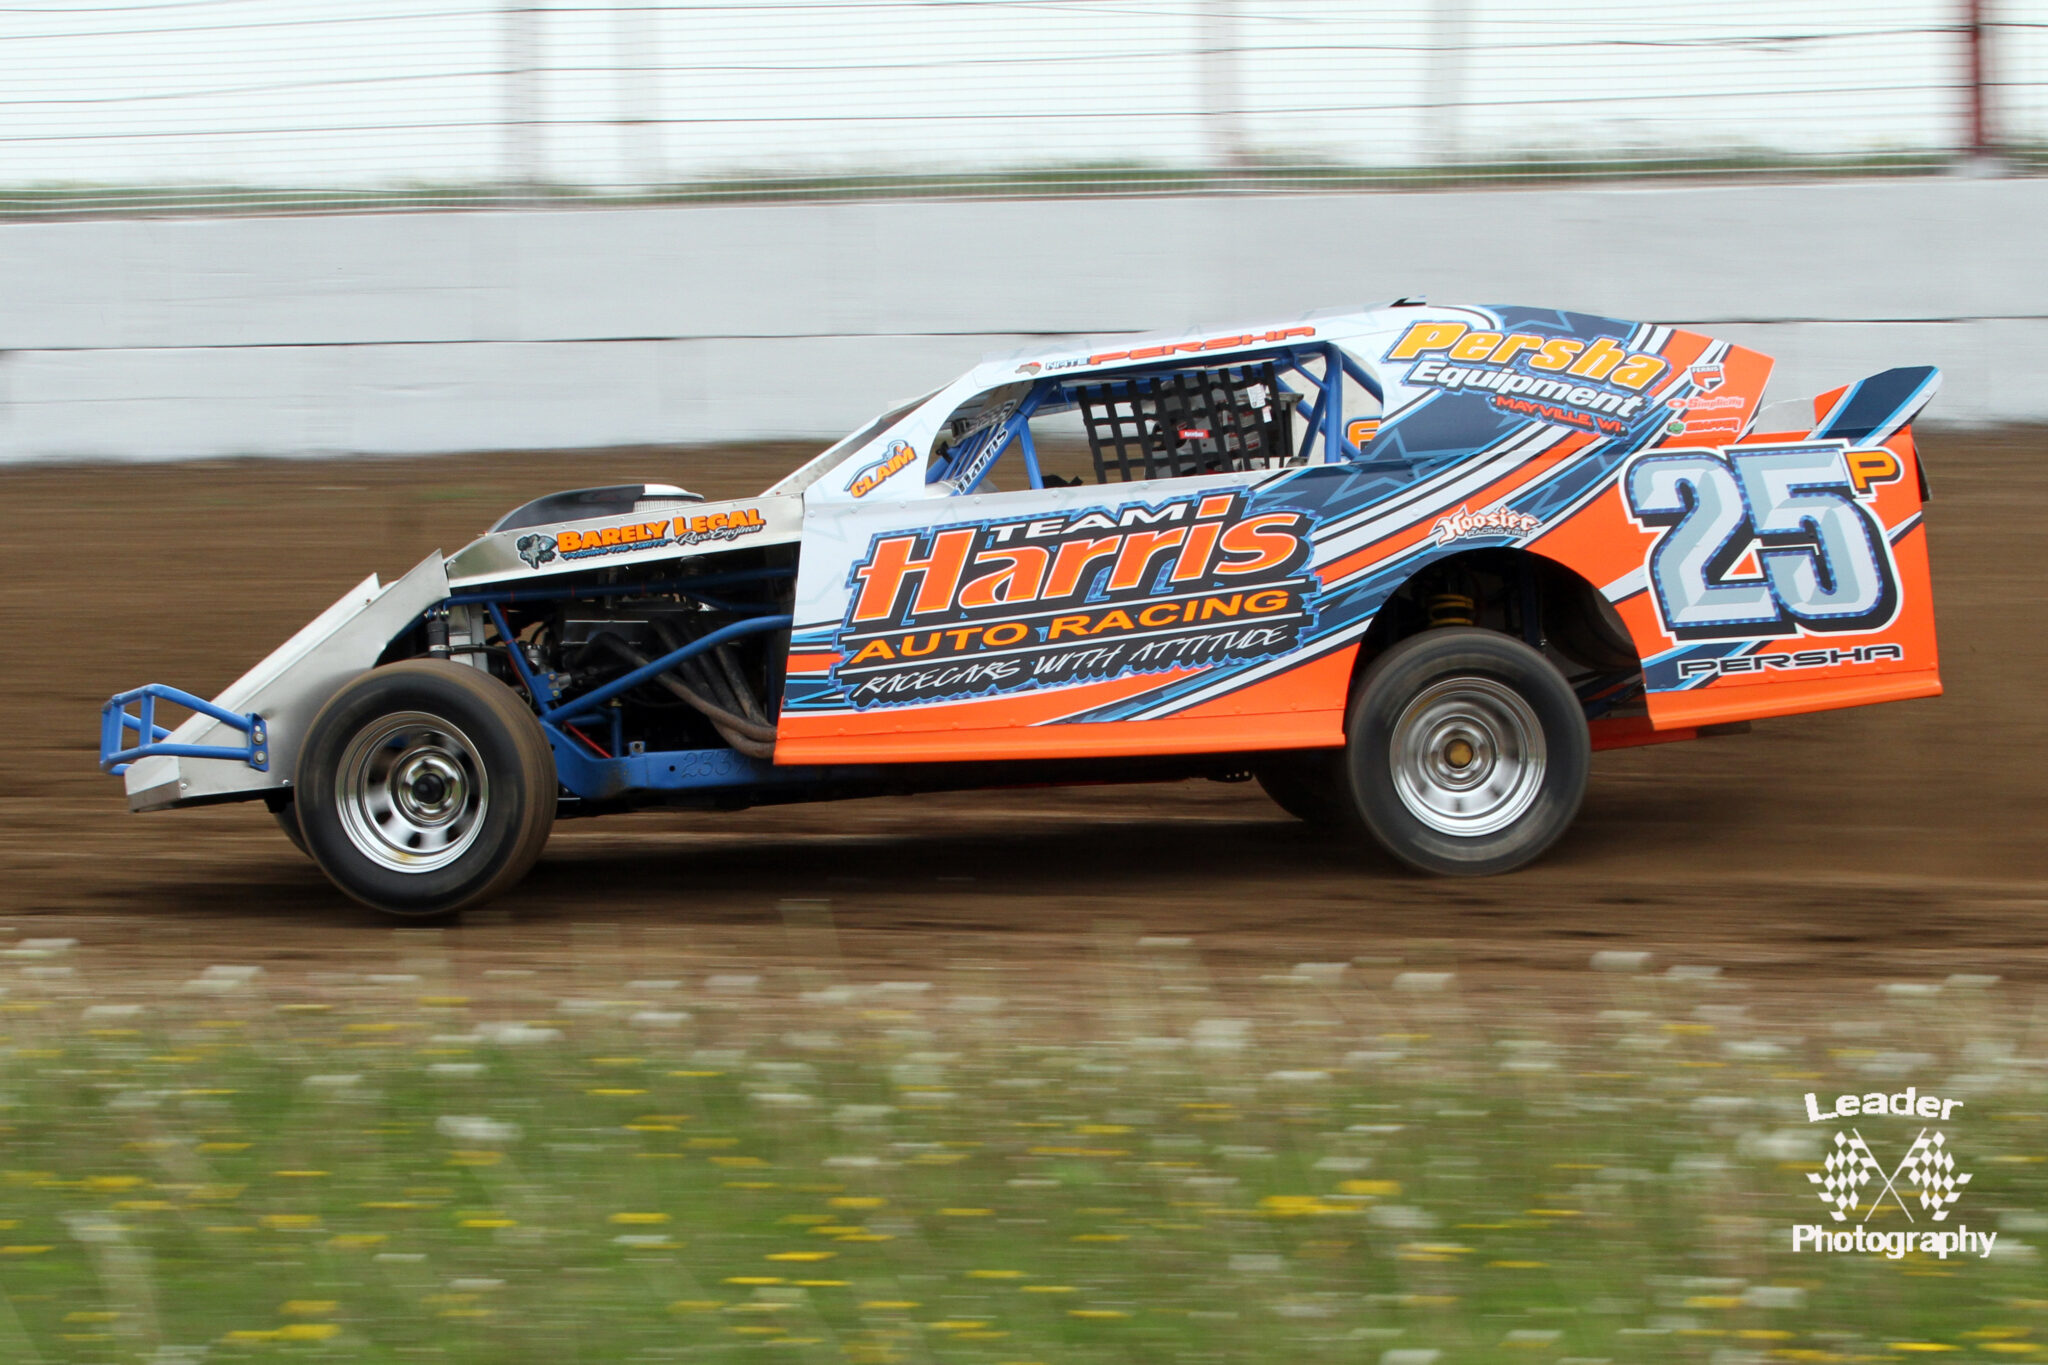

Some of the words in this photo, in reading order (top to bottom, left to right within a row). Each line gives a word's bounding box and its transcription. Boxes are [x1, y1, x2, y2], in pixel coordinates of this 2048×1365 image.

[1089, 326, 1316, 366] PERSHA
[1387, 321, 1667, 391] Persha
[1407, 361, 1646, 419] Equipment
[850, 446, 917, 498] CLAIM
[557, 520, 670, 553] BARELY
[672, 508, 766, 537] LEGAL
[674, 530, 712, 546] Race
[710, 525, 761, 541] Engines
[996, 503, 1187, 541] TEAM
[1437, 506, 1538, 543] Hoosier
[1622, 442, 1899, 641] 25
[1845, 449, 1899, 492] P
[852, 494, 1303, 623] Harris
[850, 622, 1028, 664] AUTO
[1049, 590, 1290, 637] RACING
[855, 659, 1021, 697] RACECARS
[1033, 645, 1124, 676] WITH
[1129, 624, 1290, 663] ATTITUDE
[1680, 645, 1902, 678] PERSHA
